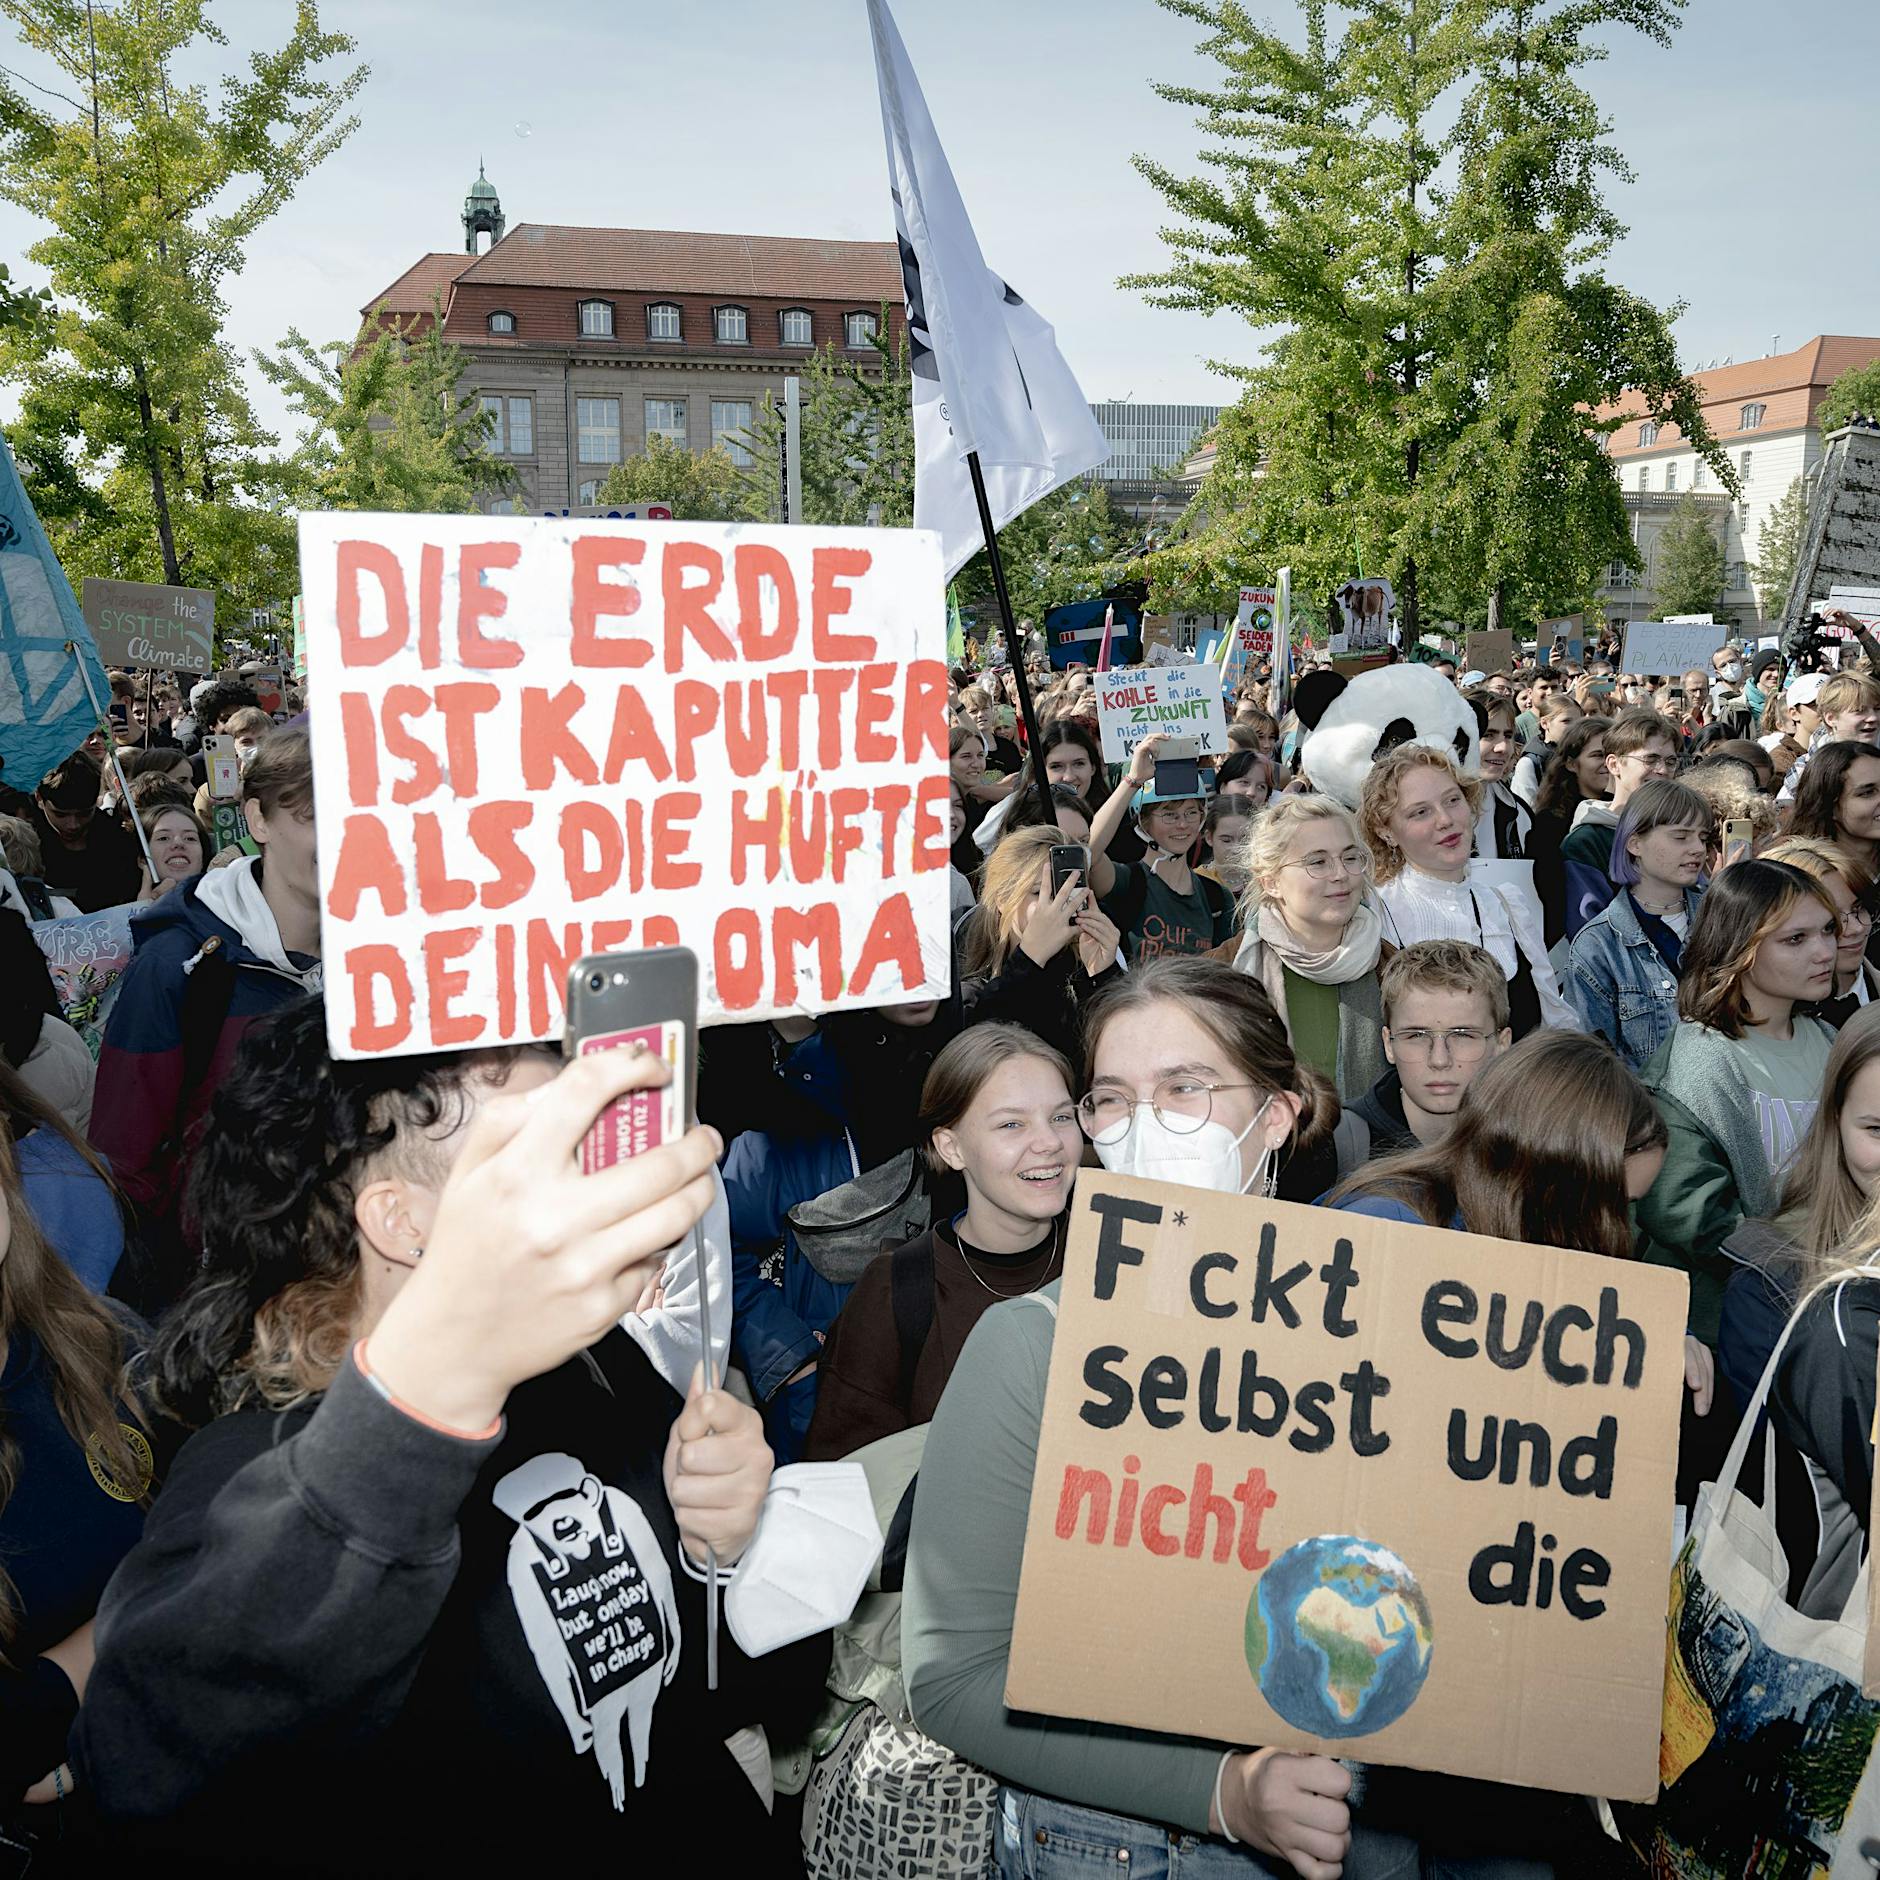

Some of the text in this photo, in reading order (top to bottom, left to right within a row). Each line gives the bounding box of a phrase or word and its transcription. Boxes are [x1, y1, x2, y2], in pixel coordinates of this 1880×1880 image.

[172, 596, 197, 618] the
[336, 536, 878, 674] DIE ERDE
[1240, 592, 1275, 605] ZUKUN
[100, 610, 184, 640] SYSTEM
[128, 636, 204, 669] Climate
[1243, 640, 1273, 652] FADEN
[1107, 669, 1186, 686] Steckt die
[1102, 683, 1202, 711] KOHLE in die
[1131, 699, 1211, 723] ZUKUNFT
[339, 659, 950, 807] IST KAPUTTER
[1117, 722, 1182, 738] nicht ins
[328, 800, 536, 921] ALS
[559, 792, 701, 902] DIE
[730, 770, 951, 887] HÜFTE
[1143, 914, 1193, 944] Our
[346, 893, 926, 1052] DEIN OMA
[1421, 1279, 1647, 1389] euch
[1079, 1344, 1618, 1500] selbst und
[1054, 1454, 1611, 1621] nicht die
[558, 1609, 594, 1640] but
[620, 1579, 650, 1606] day
[583, 1614, 646, 1658] we'll be
[607, 1632, 656, 1673] charge
